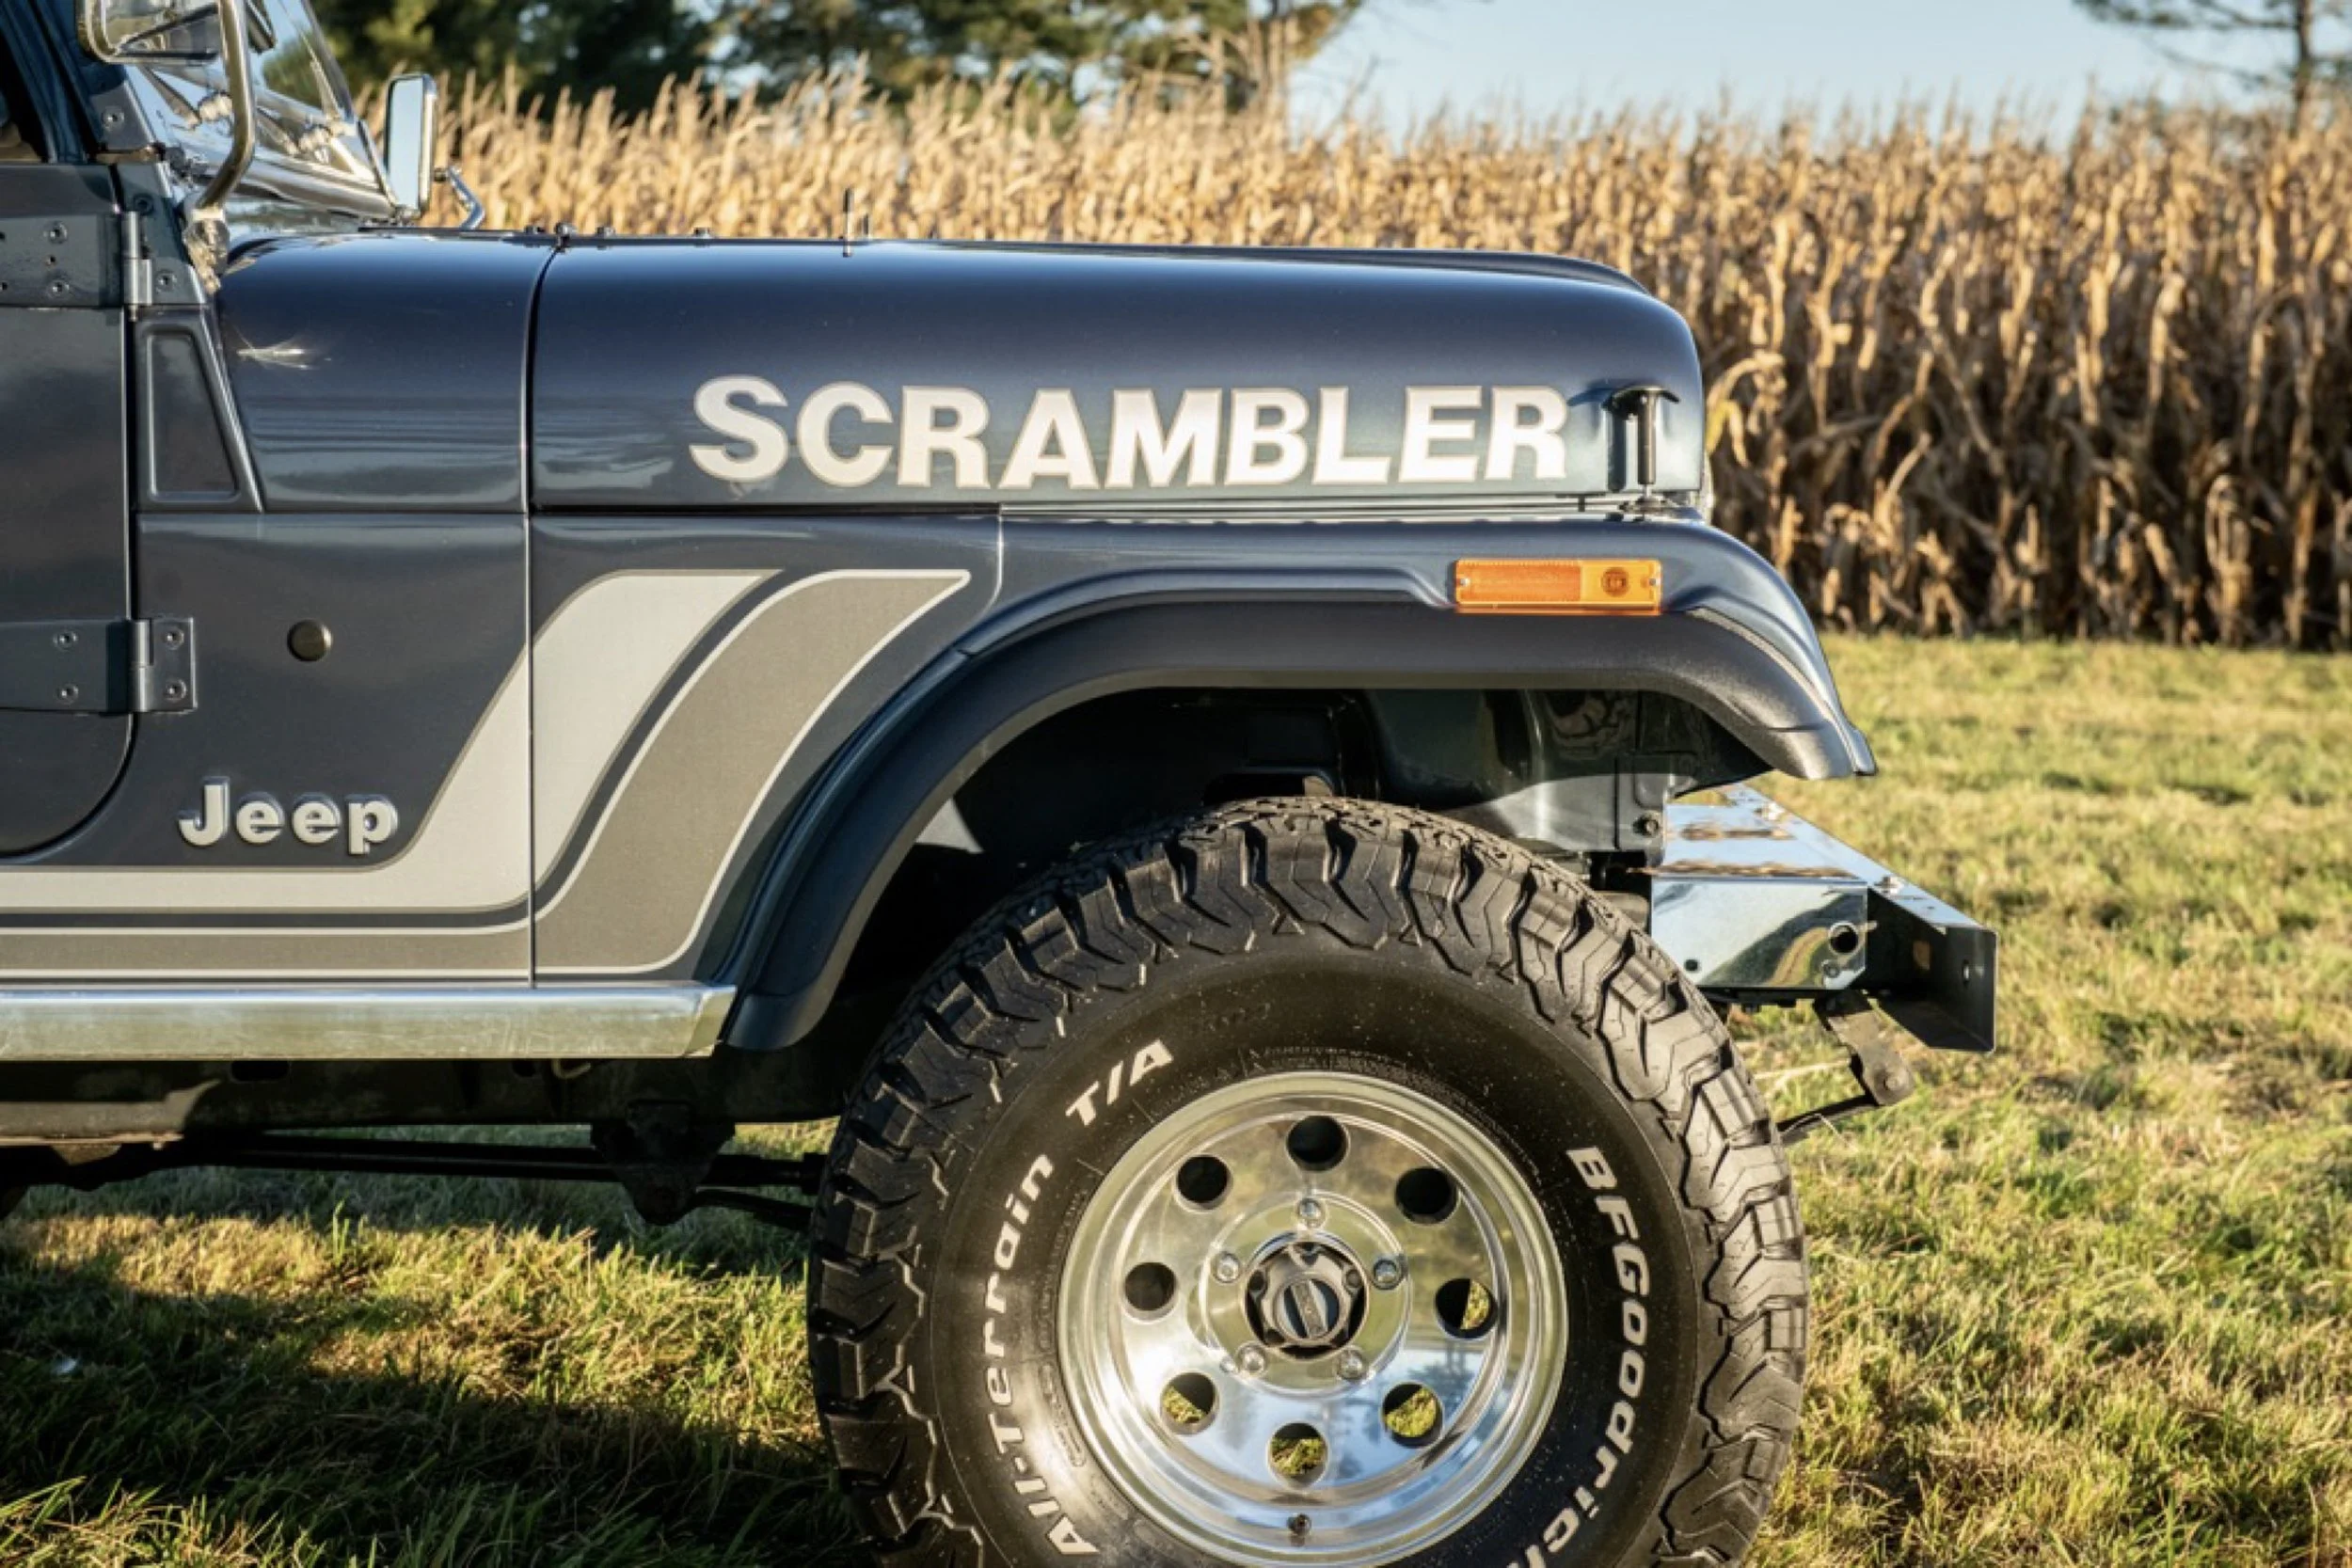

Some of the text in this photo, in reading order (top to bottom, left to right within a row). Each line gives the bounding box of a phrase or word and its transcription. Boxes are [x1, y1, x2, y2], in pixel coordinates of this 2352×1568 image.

[690, 375, 1570, 489] SCRAMBLER
[178, 776, 397, 854] Jeep
[983, 1155, 1100, 1554] All-Terrain
[1065, 1039, 1173, 1125] T/A
